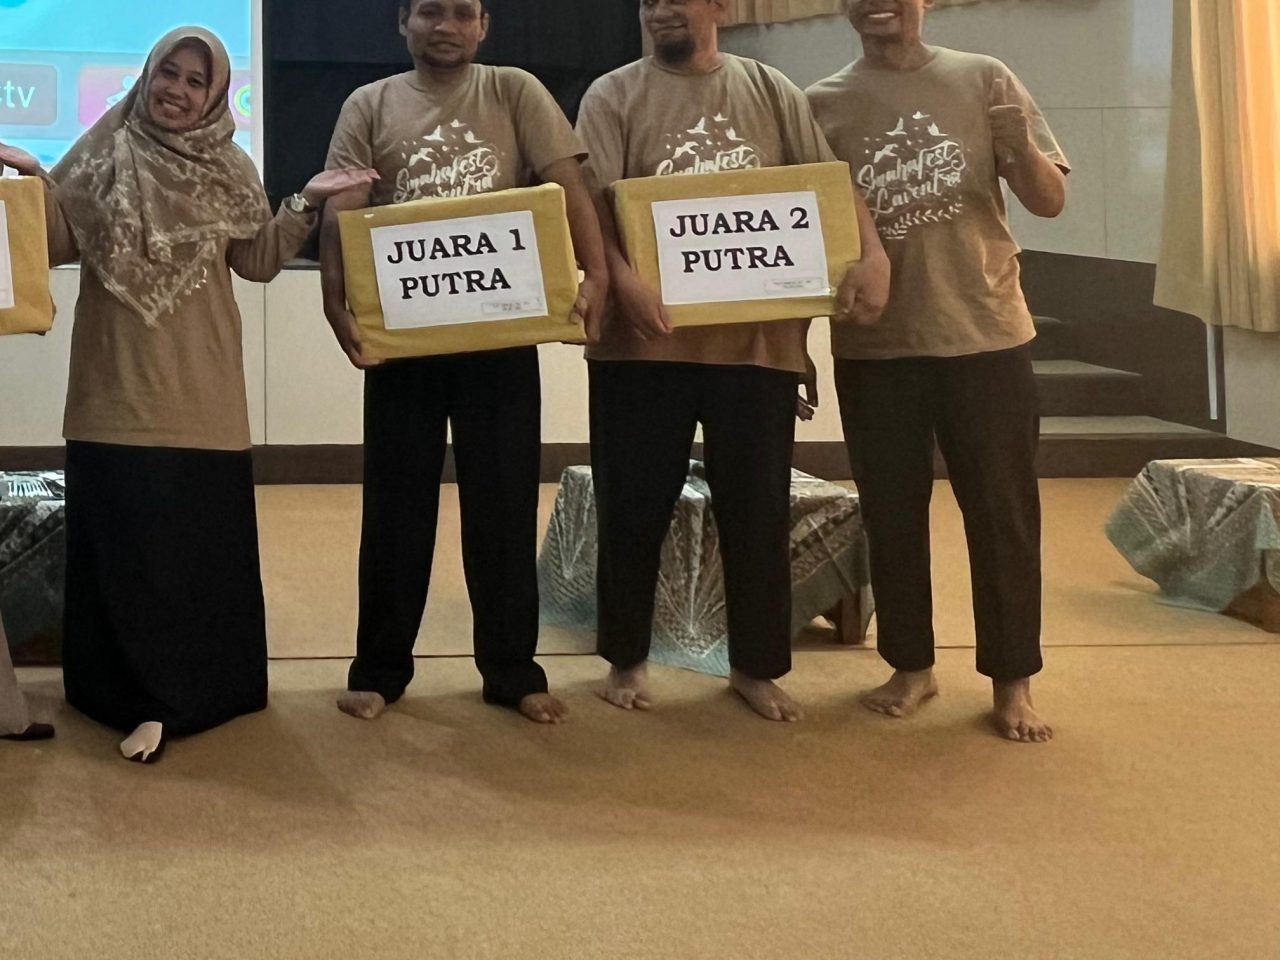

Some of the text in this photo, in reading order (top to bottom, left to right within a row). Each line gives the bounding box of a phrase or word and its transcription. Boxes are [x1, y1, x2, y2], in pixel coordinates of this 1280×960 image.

[3, 80, 36, 109] tv
[669, 206, 810, 238] JUARA 2
[387, 228, 526, 265] JUARA 1
[680, 245, 795, 273] PUTRA
[398, 267, 512, 300] PUTRA
